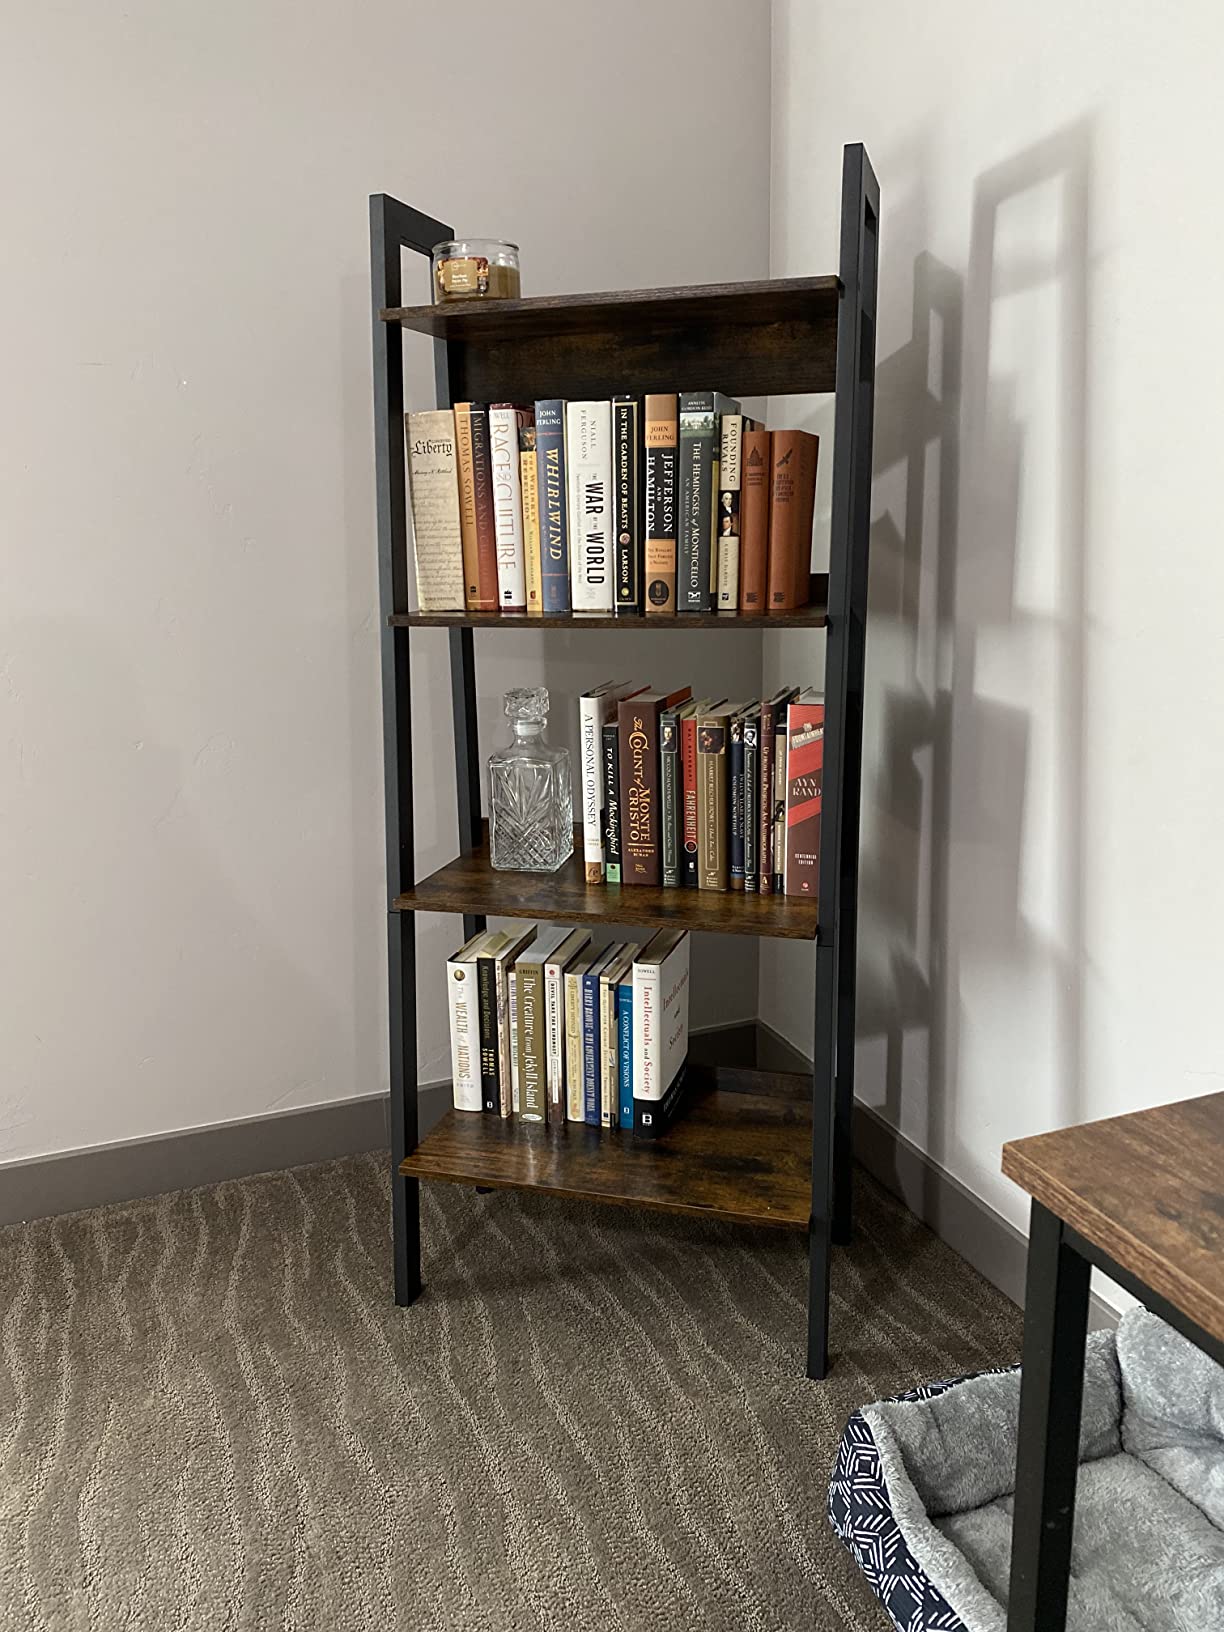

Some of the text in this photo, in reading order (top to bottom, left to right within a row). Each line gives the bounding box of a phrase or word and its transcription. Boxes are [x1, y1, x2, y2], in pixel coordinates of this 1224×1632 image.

[539, 409, 557, 418] JOHN
[620, 409, 628, 419] IN
[651, 426, 669, 434] JOHN
[580, 409, 588, 460] FERGUSON
[620, 421, 628, 440] THE
[411, 440, 453, 457] Liberty
[493, 424, 511, 471] RACE
[620, 442, 628, 482] GARDEN
[729, 423, 737, 482] FOUNDING
[460, 419, 475, 526] THOMAS SOWELL
[472, 418, 487, 530] MIGRATIONS AND
[684, 478, 690, 487] AN
[545, 448, 562, 561] WHIRLWIND
[586, 482, 604, 515] WAR
[621, 484, 628, 495] OF
[648, 456, 656, 531] HAMILTON
[661, 454, 673, 532] JEFFERSON
[690, 442, 702, 587] THE HEMINGSES of MONTICELLO
[586, 532, 605, 584] WORLD
[584, 714, 593, 722] A
[585, 725, 595, 777] PERSONAL
[606, 747, 613, 759] TO
[628, 716, 650, 789] The COUNT of
[763, 746, 770, 755] UP
[793, 786, 822, 796] RAND
[795, 778, 816, 787] AYN
[586, 779, 597, 827] ODYSSEY
[628, 788, 640, 840] CRISTO
[639, 788, 651, 841] MONTE
[686, 790, 697, 840] FAHRENHEIT
[605, 799, 619, 855] Mockingbird
[481, 965, 491, 998] Knowledge
[523, 978, 536, 993] The
[456, 1002, 468, 1034] WEALTH
[483, 1010, 491, 1039] Decisions
[523, 995, 537, 1034] Creature
[525, 1036, 534, 1053] from
[622, 1016, 630, 1050] CONFLICT
[642, 986, 653, 1094] Intellectuals and Society
[457, 1045, 470, 1079] NATIONS
[488, 1048, 496, 1076] THOMAS
[522, 1053, 538, 1080] Jekyll
[623, 1051, 630, 1060] OF
[525, 1081, 538, 1108] Island
